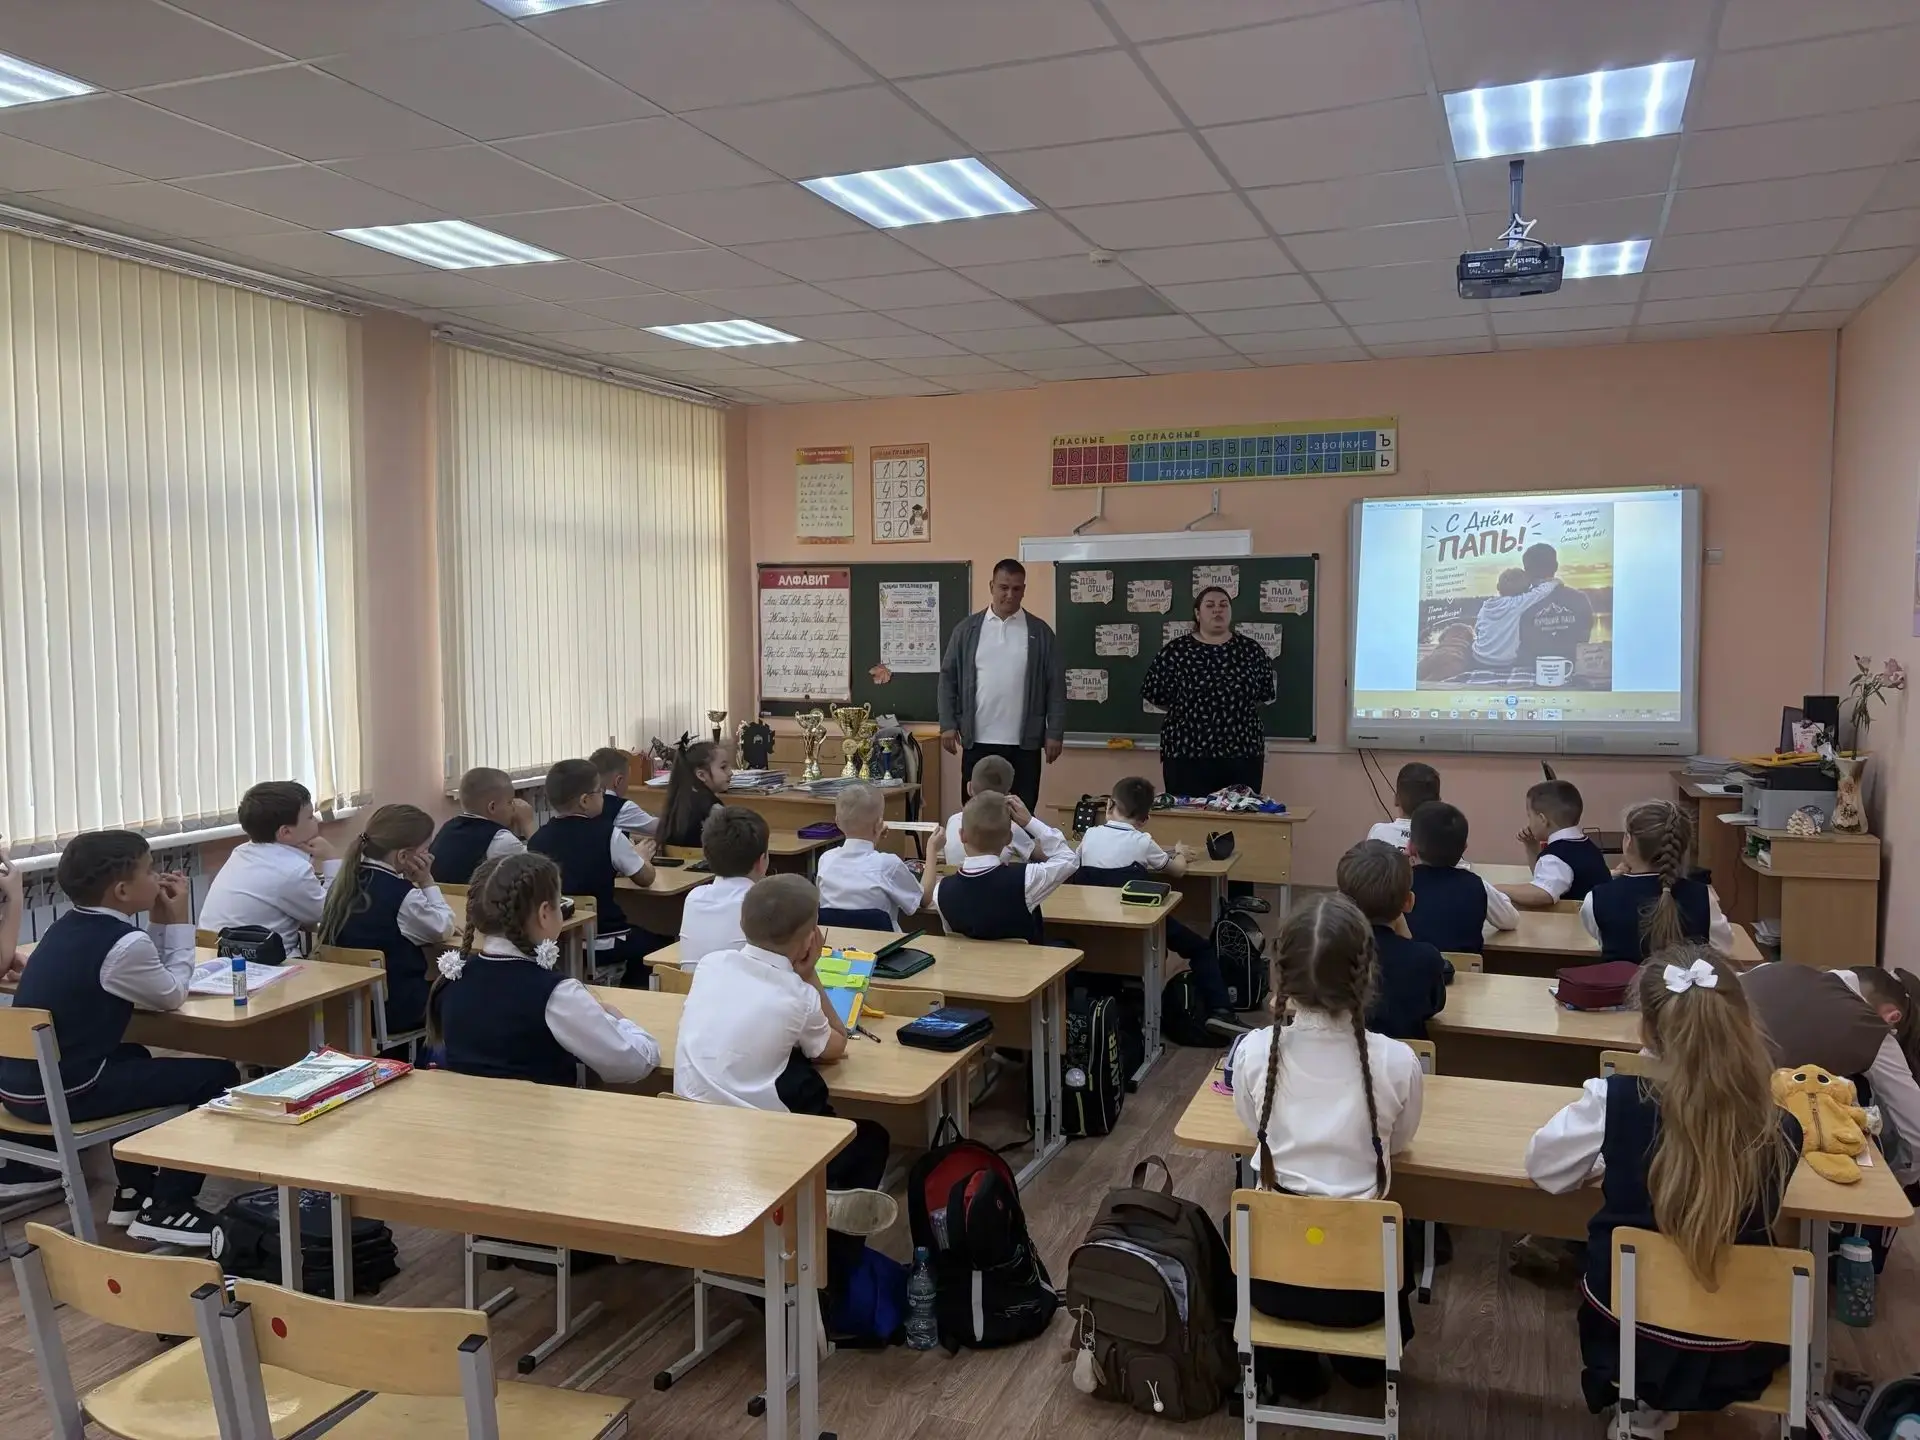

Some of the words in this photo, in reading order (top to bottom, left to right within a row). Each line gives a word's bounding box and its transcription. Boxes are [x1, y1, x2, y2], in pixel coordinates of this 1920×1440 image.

[1053, 435, 1105, 446] ГЛАСНЫЕ
[1130, 430, 1201, 441] СОГЛАСНЫЕ
[1162, 446, 1173, 457] М
[1179, 445, 1188, 456] Н
[1212, 440, 1220, 454] Б
[1228, 441, 1236, 453] В
[1260, 440, 1270, 454] Д
[1275, 439, 1288, 452] Ж
[1295, 438, 1303, 451] З
[1379, 434, 1391, 447] Ъ
[884, 461, 891, 478] 1
[898, 460, 908, 478] 2
[915, 459, 925, 477] 3
[1211, 462, 1220, 475] П
[1227, 462, 1238, 474] Ф
[1245, 461, 1252, 473] К
[1260, 461, 1268, 472] Т
[1276, 459, 1287, 472] Ш
[1294, 458, 1303, 471] С
[1311, 457, 1320, 470] Х
[1328, 457, 1337, 471] Ц
[1346, 456, 1355, 468] Ч
[1360, 454, 1374, 468] Щ
[1380, 454, 1389, 467] Ь
[882, 481, 891, 498] 4
[898, 480, 908, 498] 5
[915, 479, 925, 497] 6
[882, 501, 891, 518] 7
[898, 500, 908, 518] 8
[1446, 513, 1460, 533] С
[1463, 510, 1514, 533] Днём
[882, 520, 892, 538] 9
[899, 520, 909, 538] 0
[1438, 526, 1527, 563] ПАПЬ!
[778, 575, 830, 586] АЛФАВИТ
[1212, 575, 1232, 584] ПАПА
[1145, 589, 1165, 597] ПАПА
[1272, 587, 1293, 595] ПАПА
[1113, 633, 1132, 641] ПАПА
[1254, 632, 1275, 641] ПАПА
[1083, 677, 1102, 685] ПАПА
